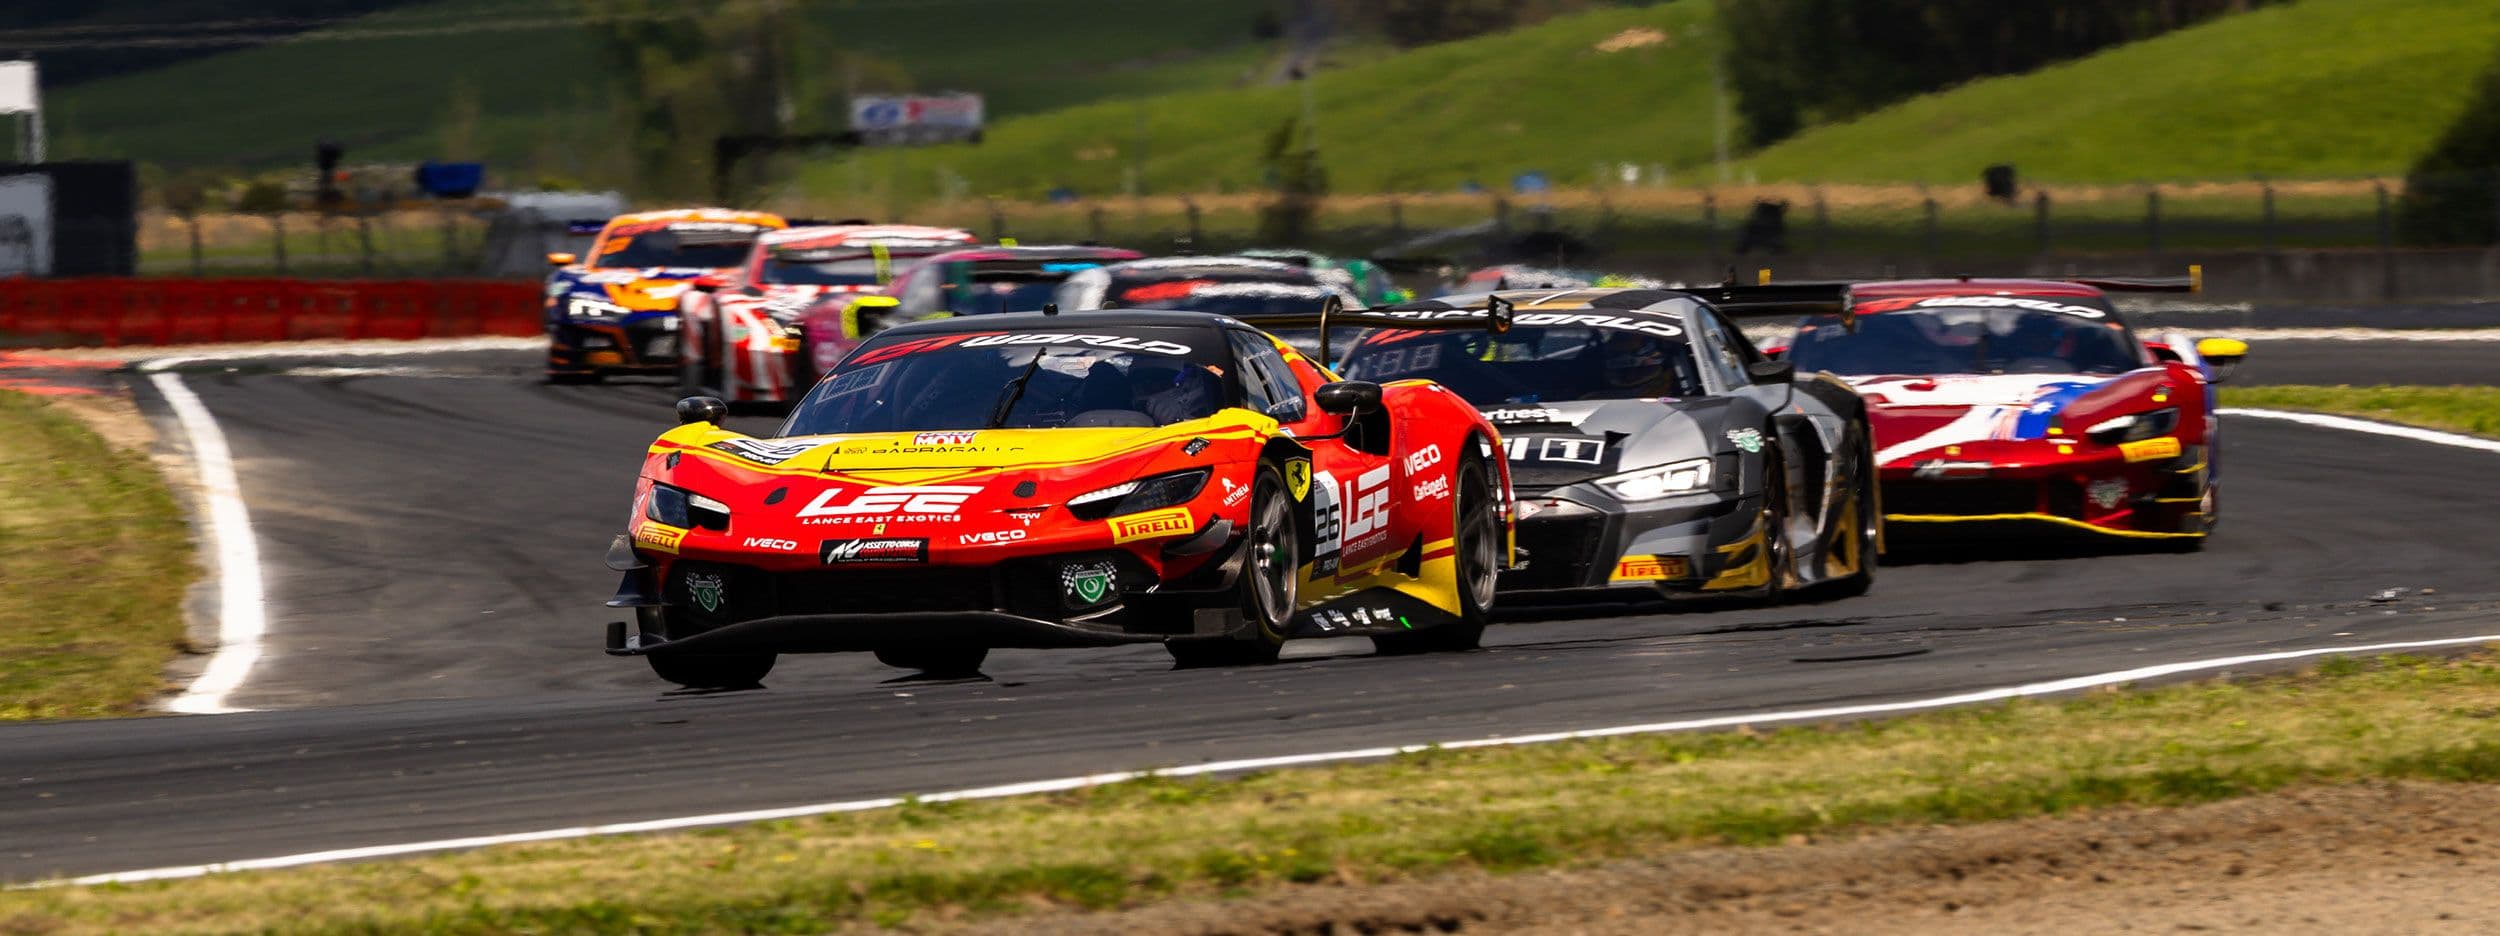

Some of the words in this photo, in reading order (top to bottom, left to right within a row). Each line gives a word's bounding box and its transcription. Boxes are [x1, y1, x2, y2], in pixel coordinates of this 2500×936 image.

[1917, 297, 2106, 318] WORLD
[959, 334, 1192, 355] WORLD
[913, 435, 975, 446] MOLY
[1403, 443, 1441, 478] IVECO
[795, 485, 985, 518] LEE
[1343, 464, 1390, 542] LEE
[802, 517, 851, 526] LANCE
[855, 515, 892, 524] EAST
[896, 514, 962, 523] EXOTICS
[1009, 512, 1041, 520] TOW
[1117, 512, 1190, 538] PIRELLI
[1315, 503, 1340, 545] 26
[637, 525, 681, 549] PIRELLI
[743, 537, 798, 551] IVECO
[959, 529, 1027, 545] IVECO
